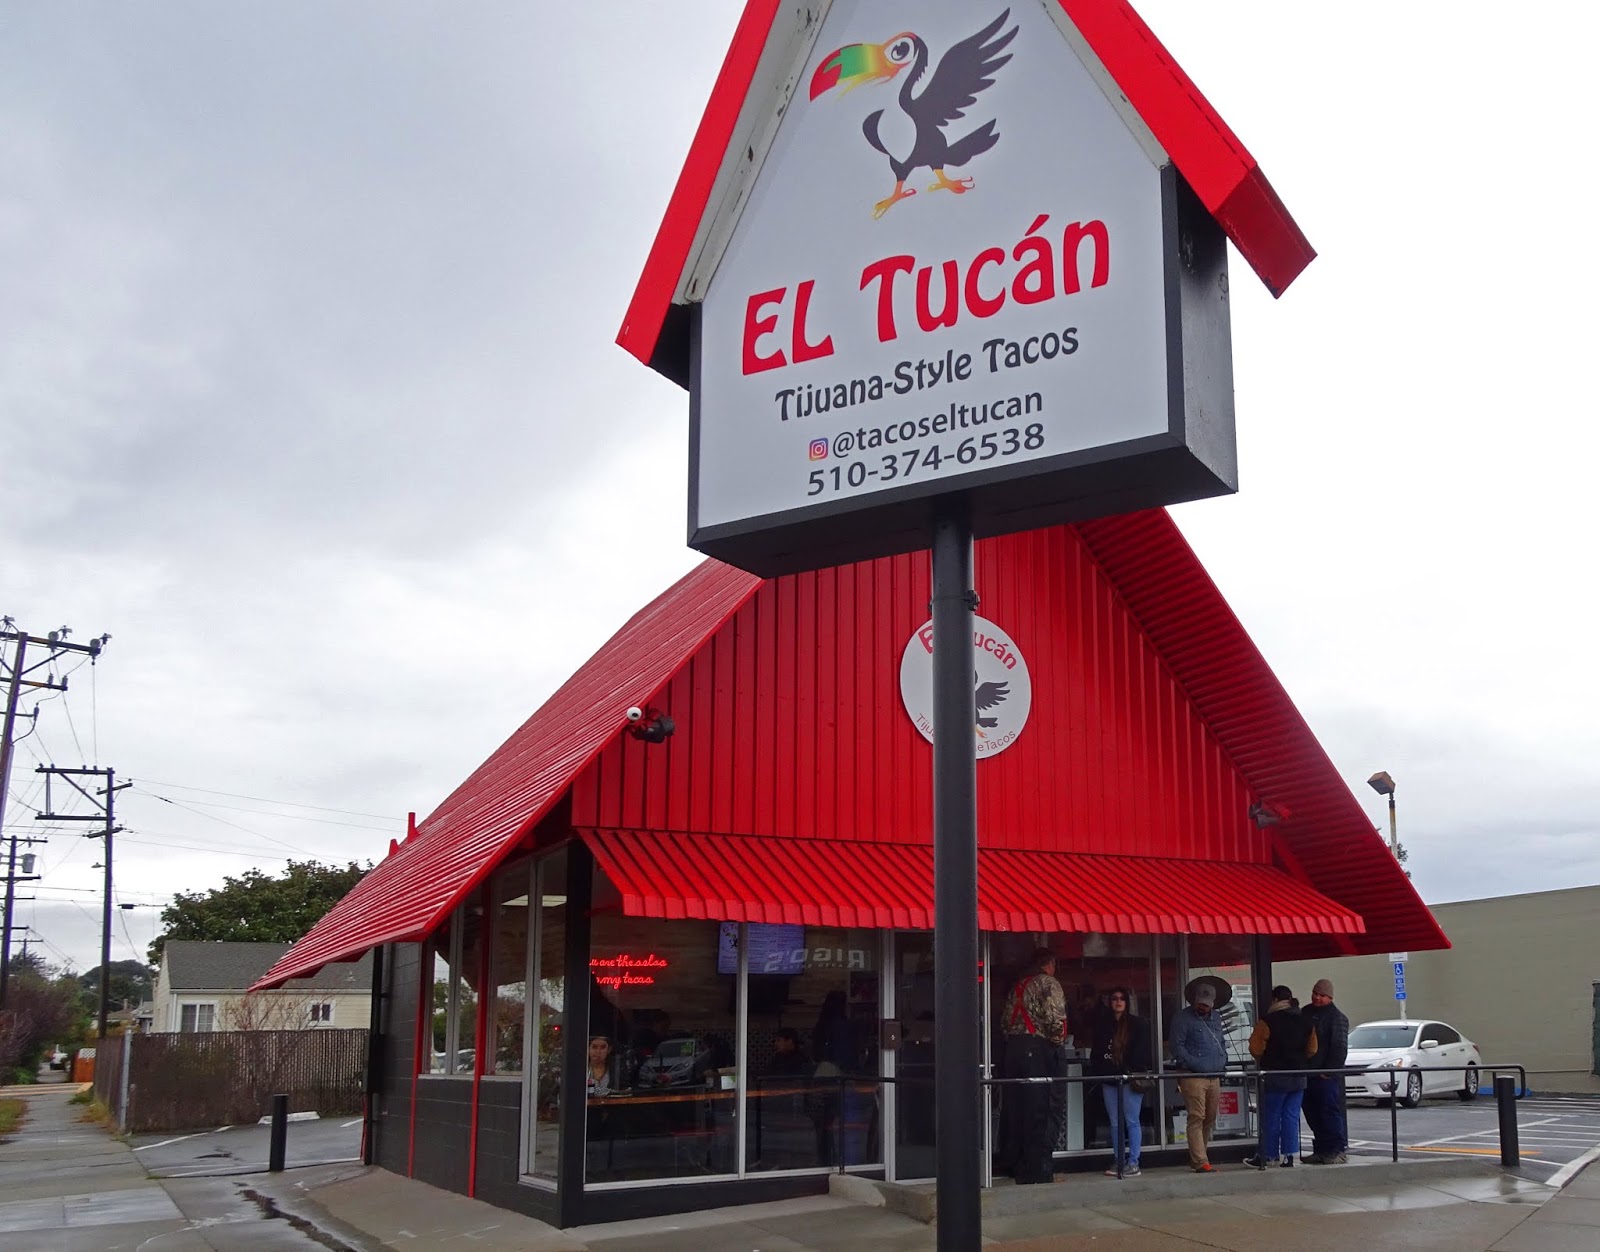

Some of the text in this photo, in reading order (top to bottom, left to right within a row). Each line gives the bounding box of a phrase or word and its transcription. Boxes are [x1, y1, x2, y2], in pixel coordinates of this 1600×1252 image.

[860, 214, 1109, 342] Tucán
[775, 327, 1078, 421] Tijuana-Style Tacos
[832, 393, 1042, 459] @tacoseltucan
[808, 423, 1044, 496] 510-374-6538
[974, 632, 1017, 670] ucán
[600, 976, 621, 990] my
[622, 972, 654, 984] tacos
[616, 954, 635, 967] the
